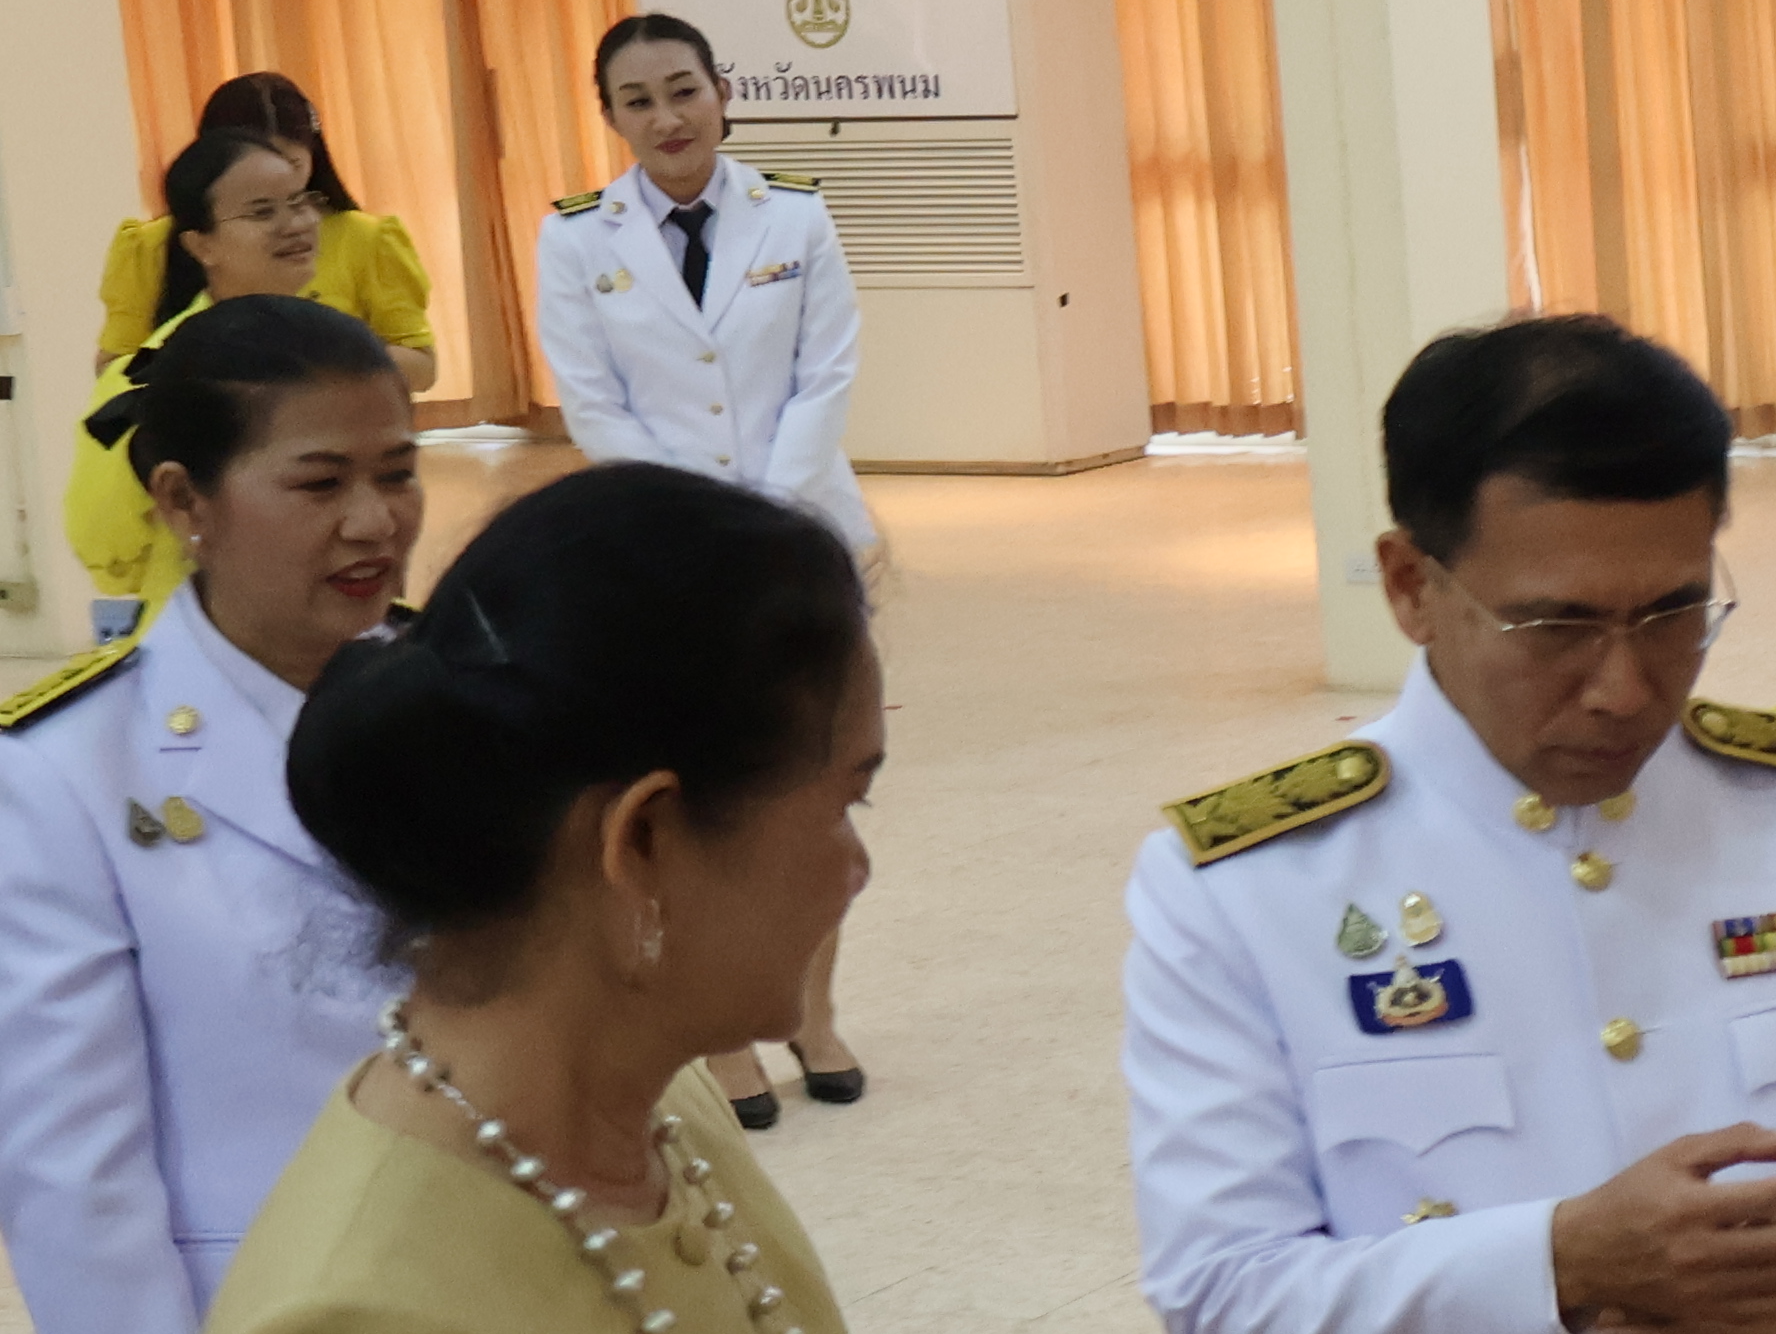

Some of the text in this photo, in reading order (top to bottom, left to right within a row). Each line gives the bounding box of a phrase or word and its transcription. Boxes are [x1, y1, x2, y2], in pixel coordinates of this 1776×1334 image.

[717, 61, 941, 101] ังหวัดนครพนม
